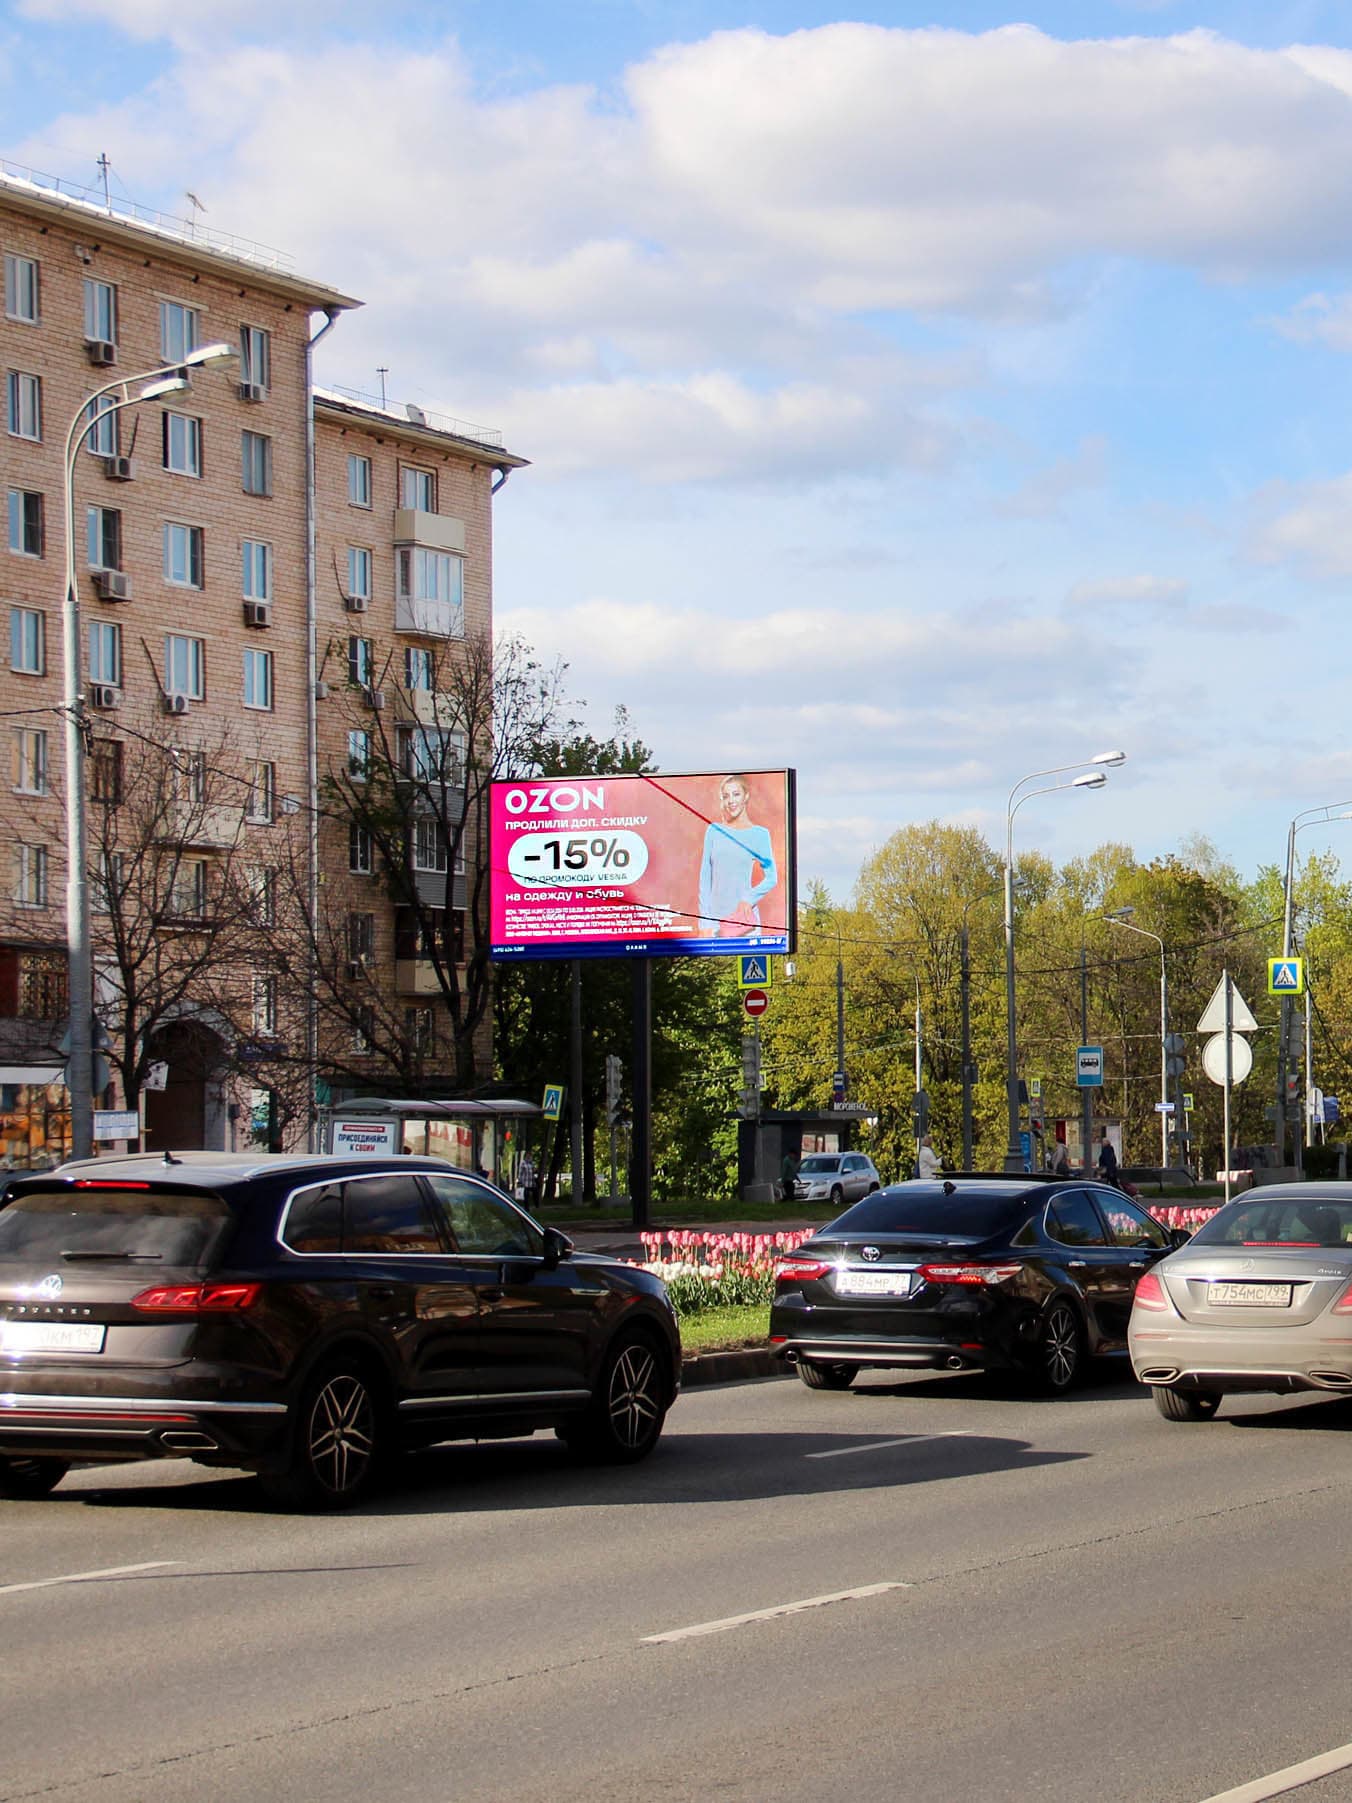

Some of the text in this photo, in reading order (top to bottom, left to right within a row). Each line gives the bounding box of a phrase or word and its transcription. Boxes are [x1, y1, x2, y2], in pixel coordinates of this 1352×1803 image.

[505, 787, 604, 814] OZON
[505, 816, 648, 831] ПРОДЛИЛИ ДОП. СКИДКУ
[524, 838, 630, 870] -15%
[505, 893, 521, 901] на
[523, 890, 573, 902] одежду
[586, 888, 624, 901] обувь
[1214, 1285, 1264, 1300] Т754МС
